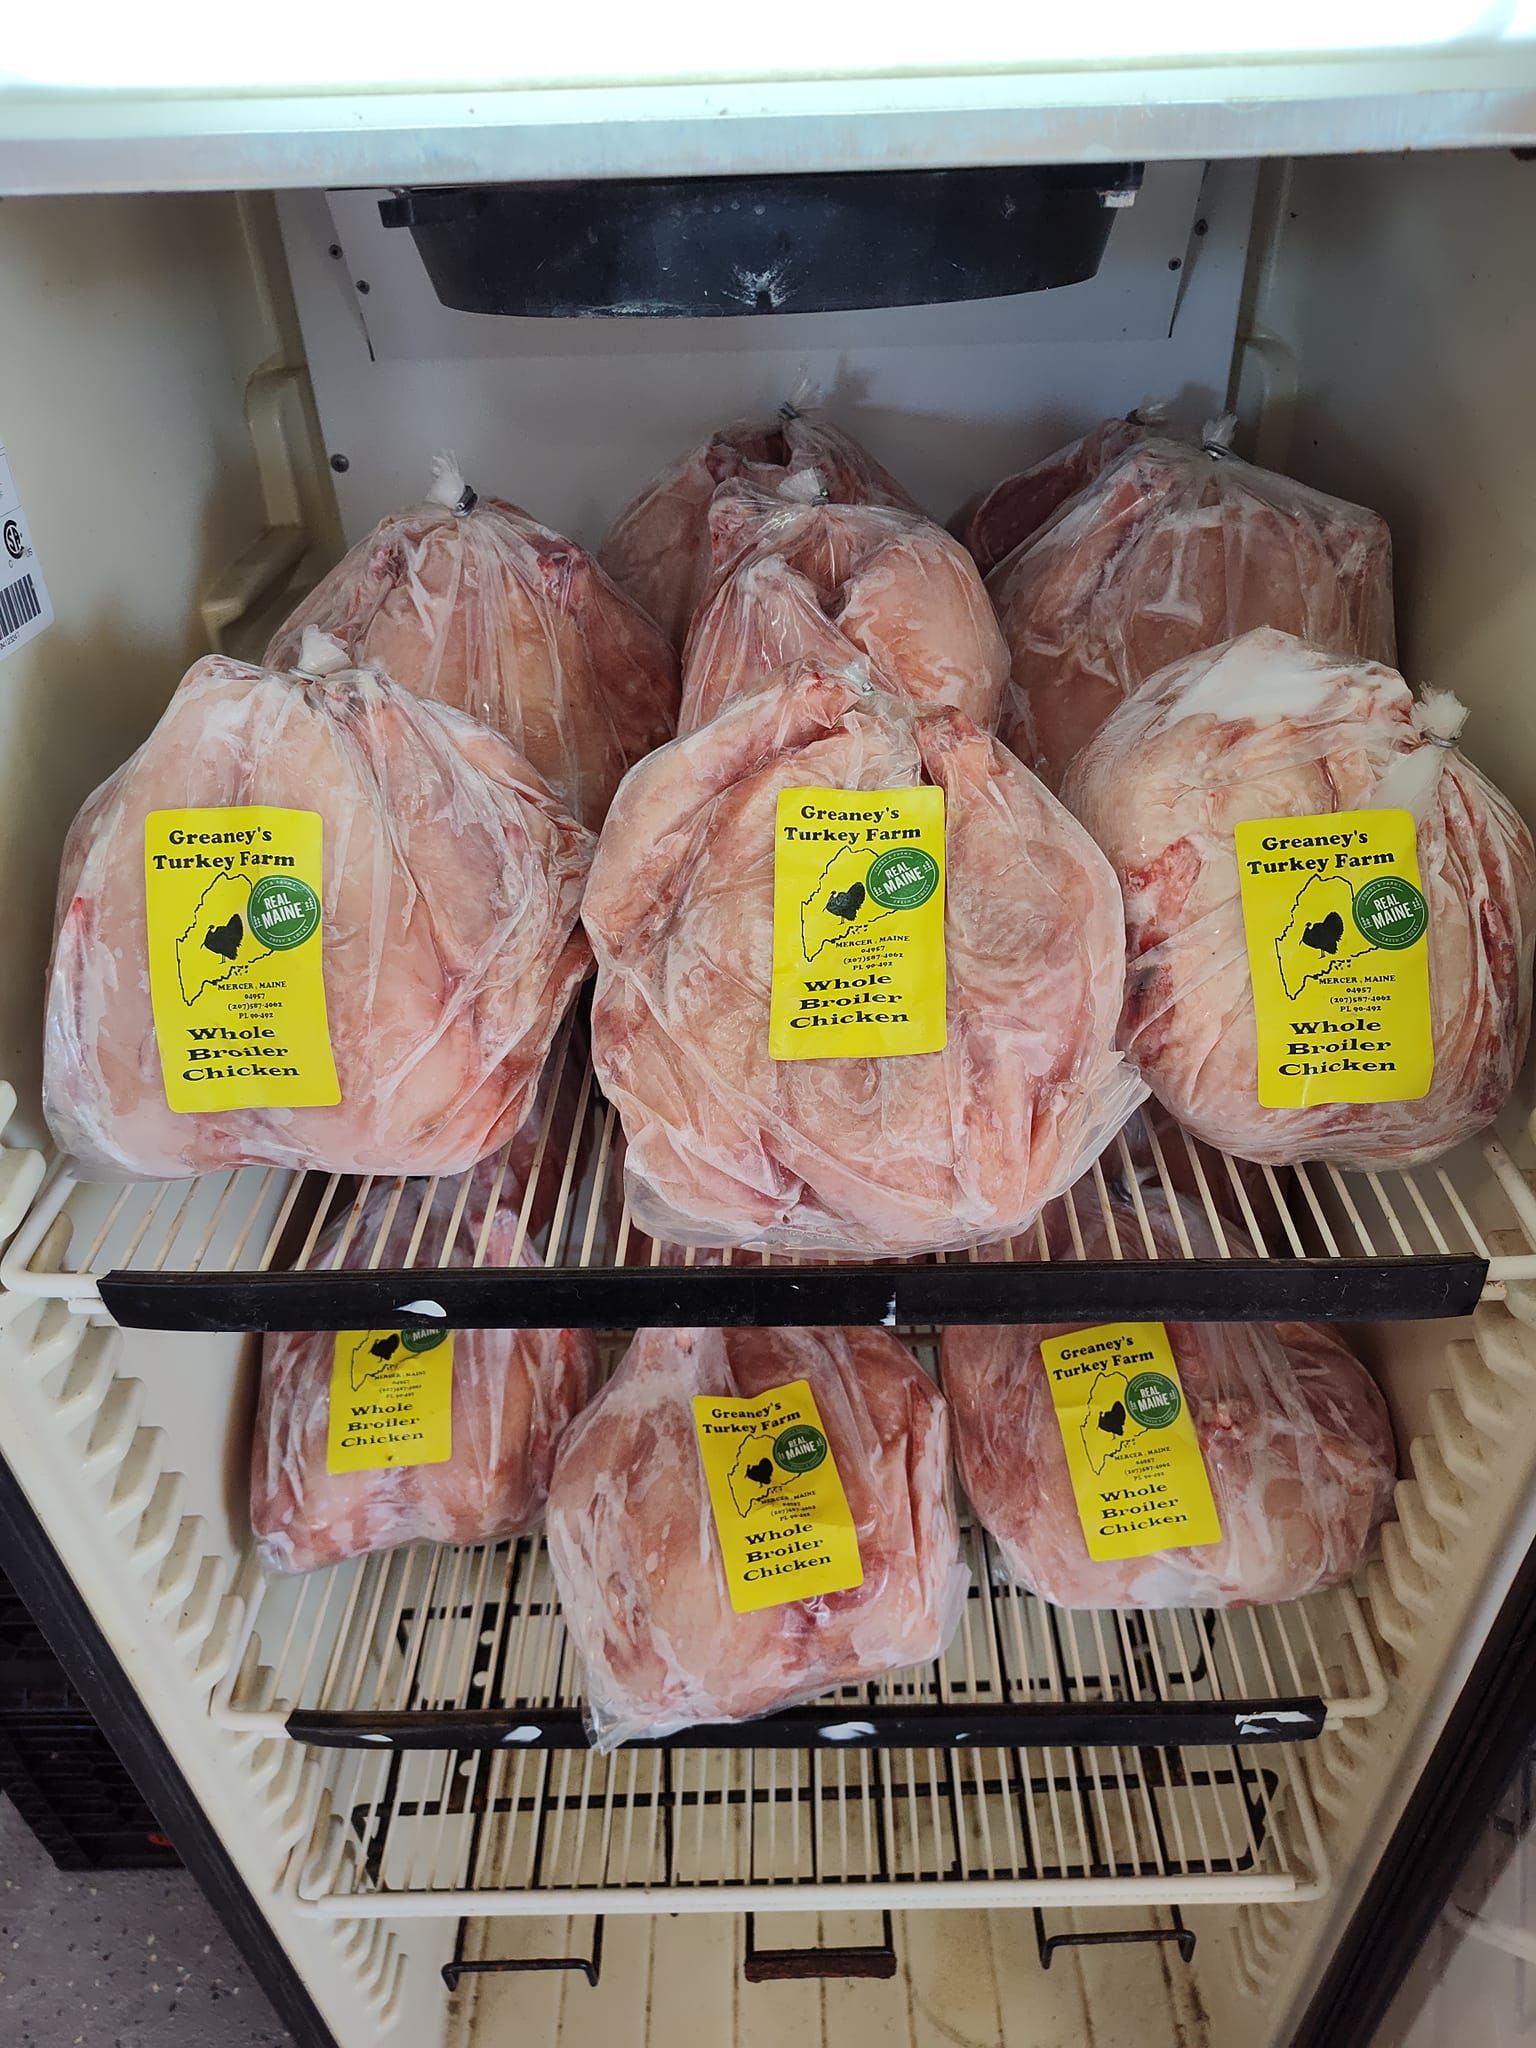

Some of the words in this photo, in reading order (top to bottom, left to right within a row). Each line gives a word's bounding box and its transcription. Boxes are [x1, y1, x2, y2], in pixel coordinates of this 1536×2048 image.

[801, 806, 900, 823] Greaney's
[169, 826, 272, 845] Greaney's
[784, 827, 860, 845] Turkey
[865, 827, 921, 842] Farm
[1262, 830, 1368, 850] Greaney's
[153, 853, 235, 870] Turkey
[239, 851, 295, 867] Farm
[1247, 856, 1329, 875] Turkey
[1335, 852, 1395, 869] Farm
[884, 861, 911, 879] REAL
[882, 866, 926, 895] MAINE
[263, 892, 291, 910] REAL
[1373, 893, 1400, 911] REAL
[261, 902, 305, 930] MAINE
[1371, 902, 1414, 930] MAINE
[835, 939, 873, 948] MERCER
[217, 983, 254, 991] MERCER
[259, 981, 287, 989] MAINE
[804, 974, 892, 992] Whole
[1364, 975, 1396, 983] MAINE
[799, 992, 903, 1010] Broiler
[790, 1011, 909, 1028] Chicken
[1290, 1019, 1382, 1035] Whole
[187, 1026, 276, 1040] Whole
[187, 1046, 288, 1061] Broiler
[1287, 1038, 1391, 1055] Broiler
[182, 1064, 300, 1081] Chicken
[1278, 1059, 1397, 1076] Chicken
[1061, 1336, 1134, 1361] Greaney's
[1053, 1359, 1108, 1380] Turkey
[1112, 1350, 1154, 1366] Farm
[1139, 1385, 1160, 1398] REAL
[350, 1403, 413, 1416] Whole
[711, 1402, 782, 1419] Greaney's
[1137, 1393, 1170, 1412] MAINE
[347, 1417, 420, 1432] Broiler
[702, 1423, 758, 1434] Turkey
[761, 1411, 801, 1431] Farm
[341, 1432, 424, 1447] Chicken
[788, 1436, 807, 1448] REAL
[785, 1441, 817, 1460] MAINE
[1100, 1483, 1168, 1502] Whole
[1100, 1498, 1179, 1519] Broiler
[745, 1523, 814, 1545] Whole
[1099, 1514, 1188, 1536] Chicken
[746, 1539, 824, 1564] Broiler
[743, 1555, 832, 1582] Chicken
